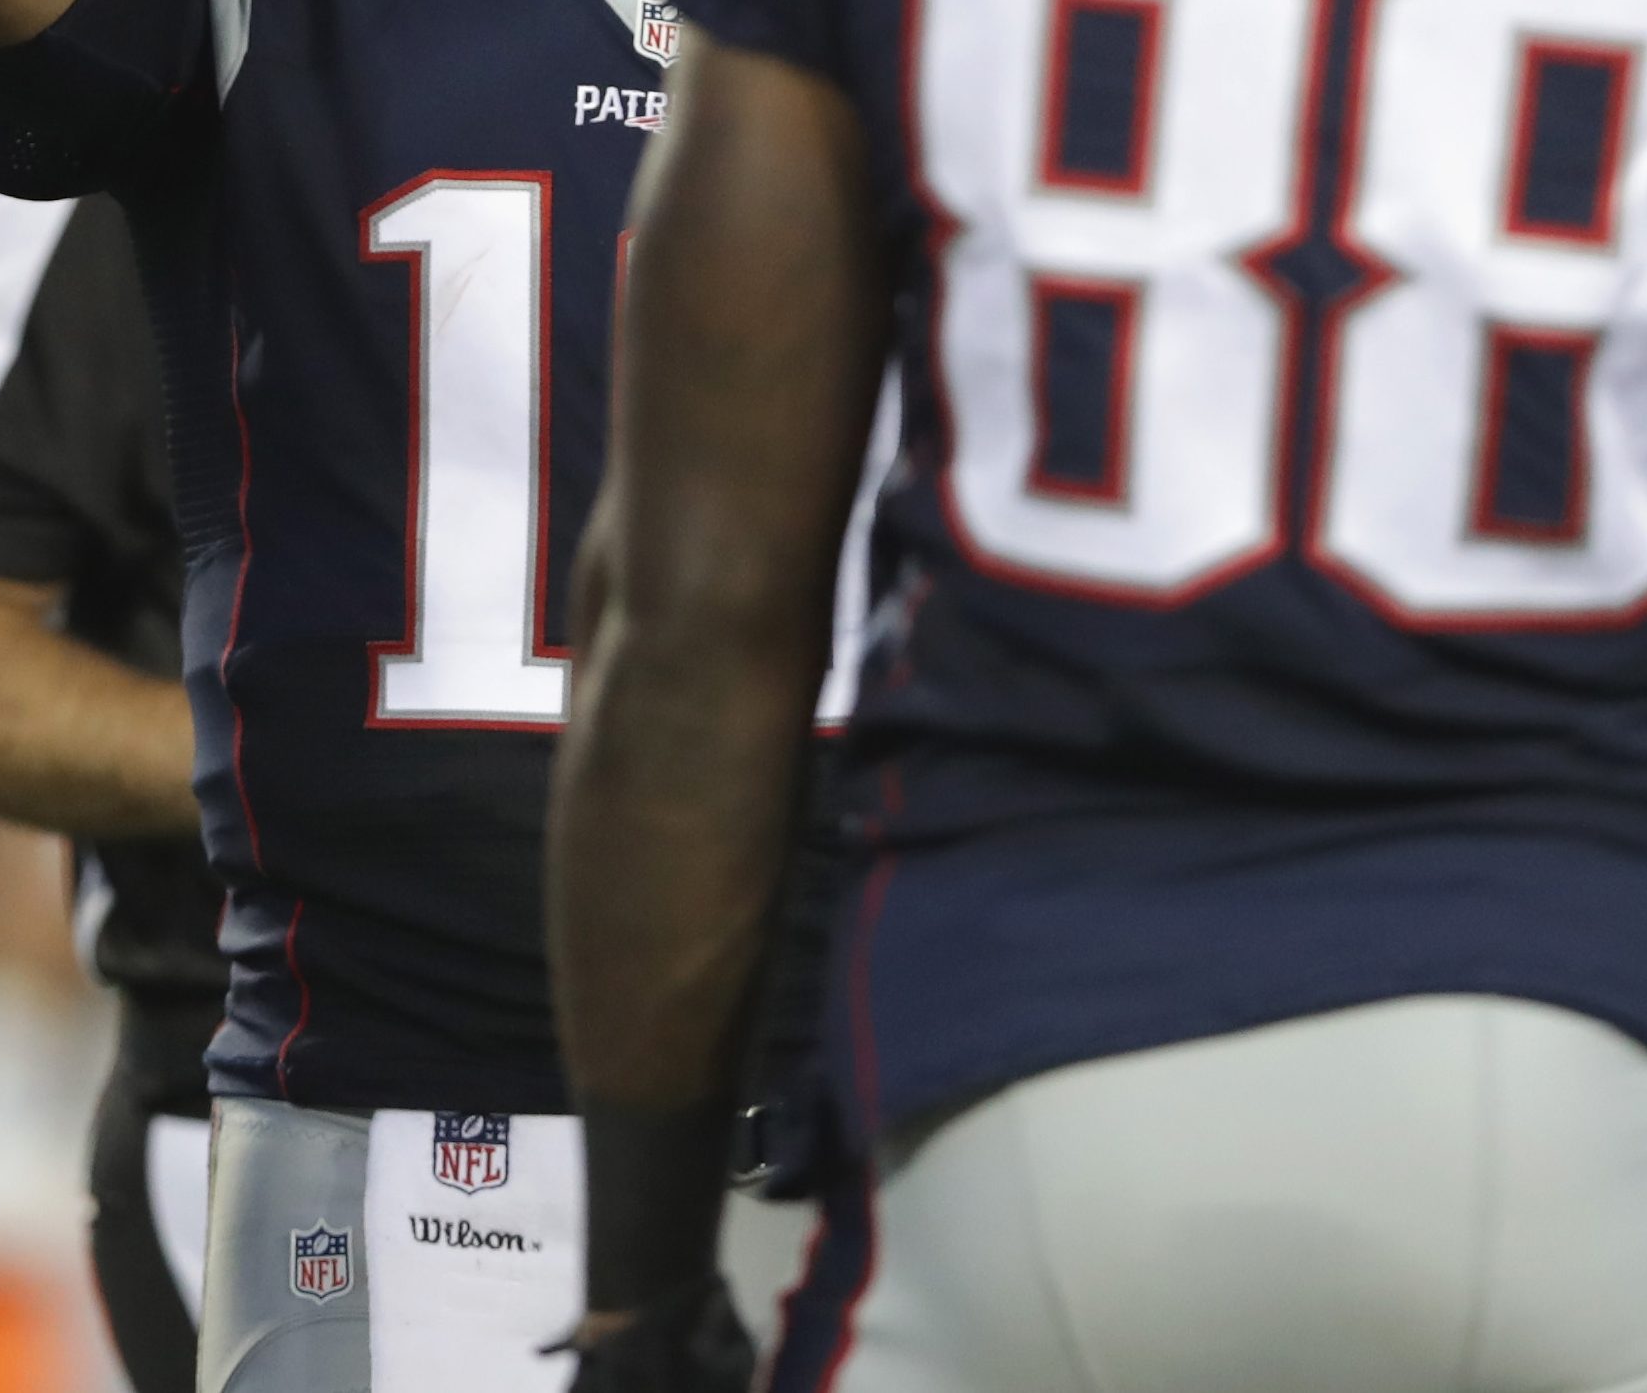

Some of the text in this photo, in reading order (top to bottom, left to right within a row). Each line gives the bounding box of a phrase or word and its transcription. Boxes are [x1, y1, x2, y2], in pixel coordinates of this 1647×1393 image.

[646, 21, 677, 55] NF
[574, 84, 669, 127] PATR
[439, 1142, 501, 1187] NFL
[409, 1215, 526, 1252] Wilson
[300, 1258, 345, 1292] NFL
